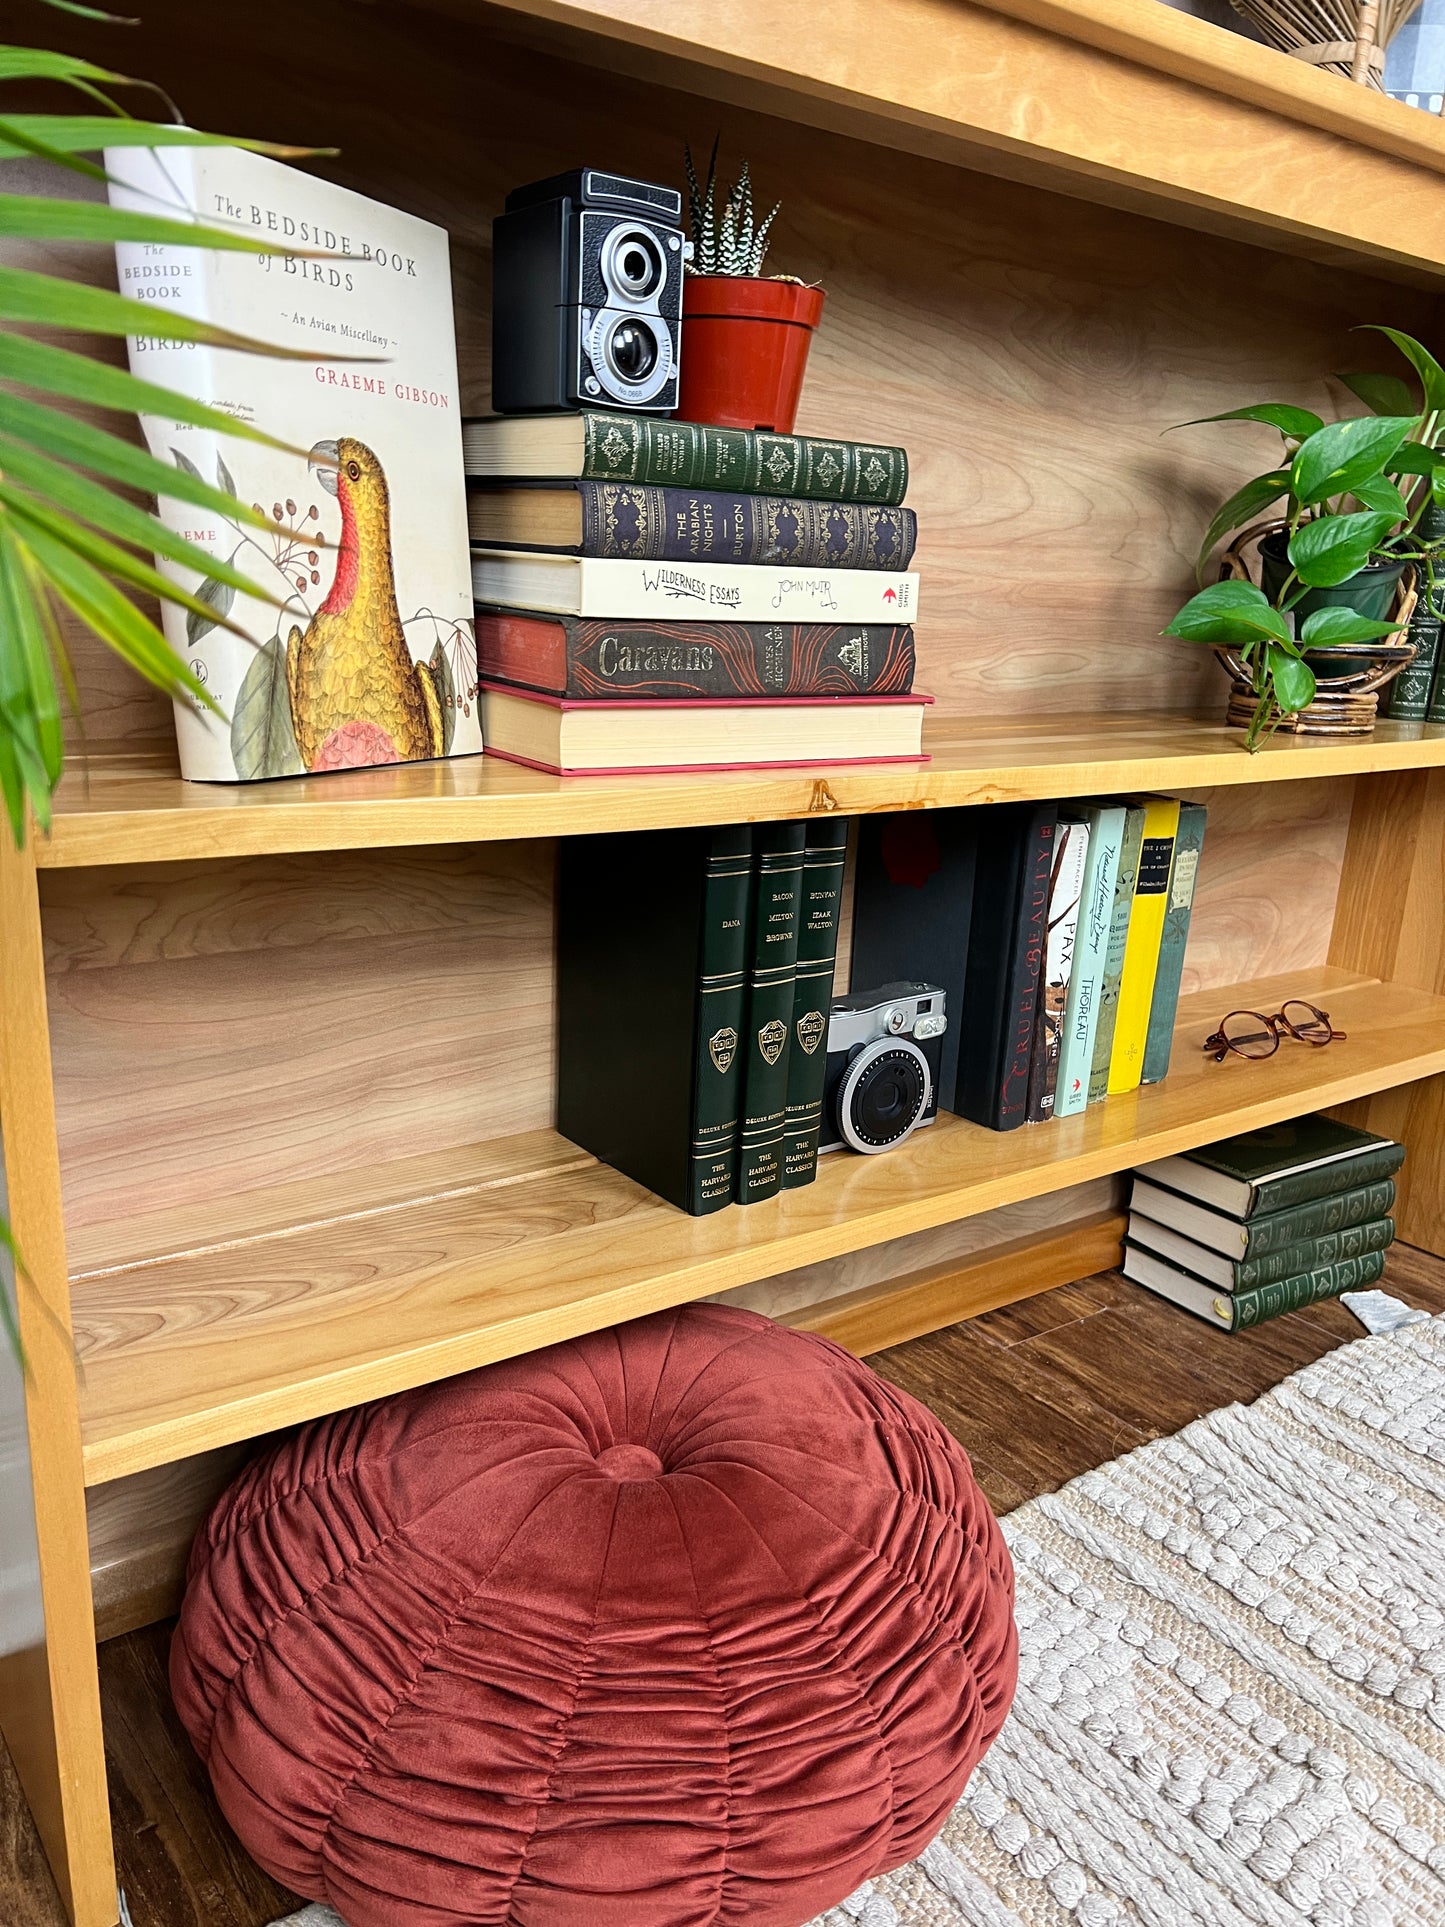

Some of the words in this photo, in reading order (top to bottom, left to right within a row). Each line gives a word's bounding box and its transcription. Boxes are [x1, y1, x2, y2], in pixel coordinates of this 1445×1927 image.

[214, 194, 242, 219] The
[250, 204, 352, 256] BEDSIDE
[361, 242, 418, 277] BOOK
[143, 245, 165, 256] The
[124, 265, 193, 279] BEDSIDE
[258, 252, 273, 272] of
[283, 255, 354, 292] BIRDS
[137, 286, 182, 299] BOOK
[292, 312, 306, 326] An
[309, 317, 337, 334] Avian
[340, 324, 389, 349] Miscellany
[315, 366, 387, 395] GRAEME
[394, 383, 449, 409] GIBSON
[656, 432, 664, 471] CHARLES
[676, 512, 687, 541] THE
[690, 499, 700, 556] ARABIAN
[703, 502, 713, 552] NIGHTS
[732, 503, 743, 557] BURTON
[642, 567, 706, 597] WILDERNESS
[709, 584, 742, 605] ESSAYS
[771, 579, 804, 609] JOHN
[805, 580, 838, 610] MUIR
[764, 627, 773, 641] A.
[600, 636, 714, 677] Caravans
[765, 644, 775, 684] JAMES
[774, 625, 784, 689] MICHENER
[860, 653, 869, 684] RANDOM
[772, 892, 794, 902] BACON
[809, 890, 837, 900] BUNYAN
[812, 910, 832, 919] IZAAK
[1025, 849, 1051, 968] BEAUTY
[722, 919, 741, 929] DANA
[768, 912, 794, 922] MILTON
[807, 921, 834, 930] WALTON
[765, 932, 793, 943] BROWNE
[1060, 922, 1076, 965] PAX
[1075, 975, 1095, 1041] THOREAU
[1002, 980, 1035, 1103] CRUEL
[785, 1104, 805, 1113] DELUXE
[745, 1115, 767, 1126] DELUXE
[698, 1125, 721, 1136] DELUXE
[795, 1140, 809, 1150] THE
[758, 1152, 772, 1162] THE
[785, 1149, 815, 1163] HARVARD
[711, 1163, 726, 1173] THE
[748, 1161, 778, 1176] HARVARD
[785, 1161, 814, 1175] CLASSICS
[701, 1172, 732, 1187] HARVARD
[748, 1174, 777, 1188] CLASSICS
[701, 1184, 731, 1199] CLASSICS
